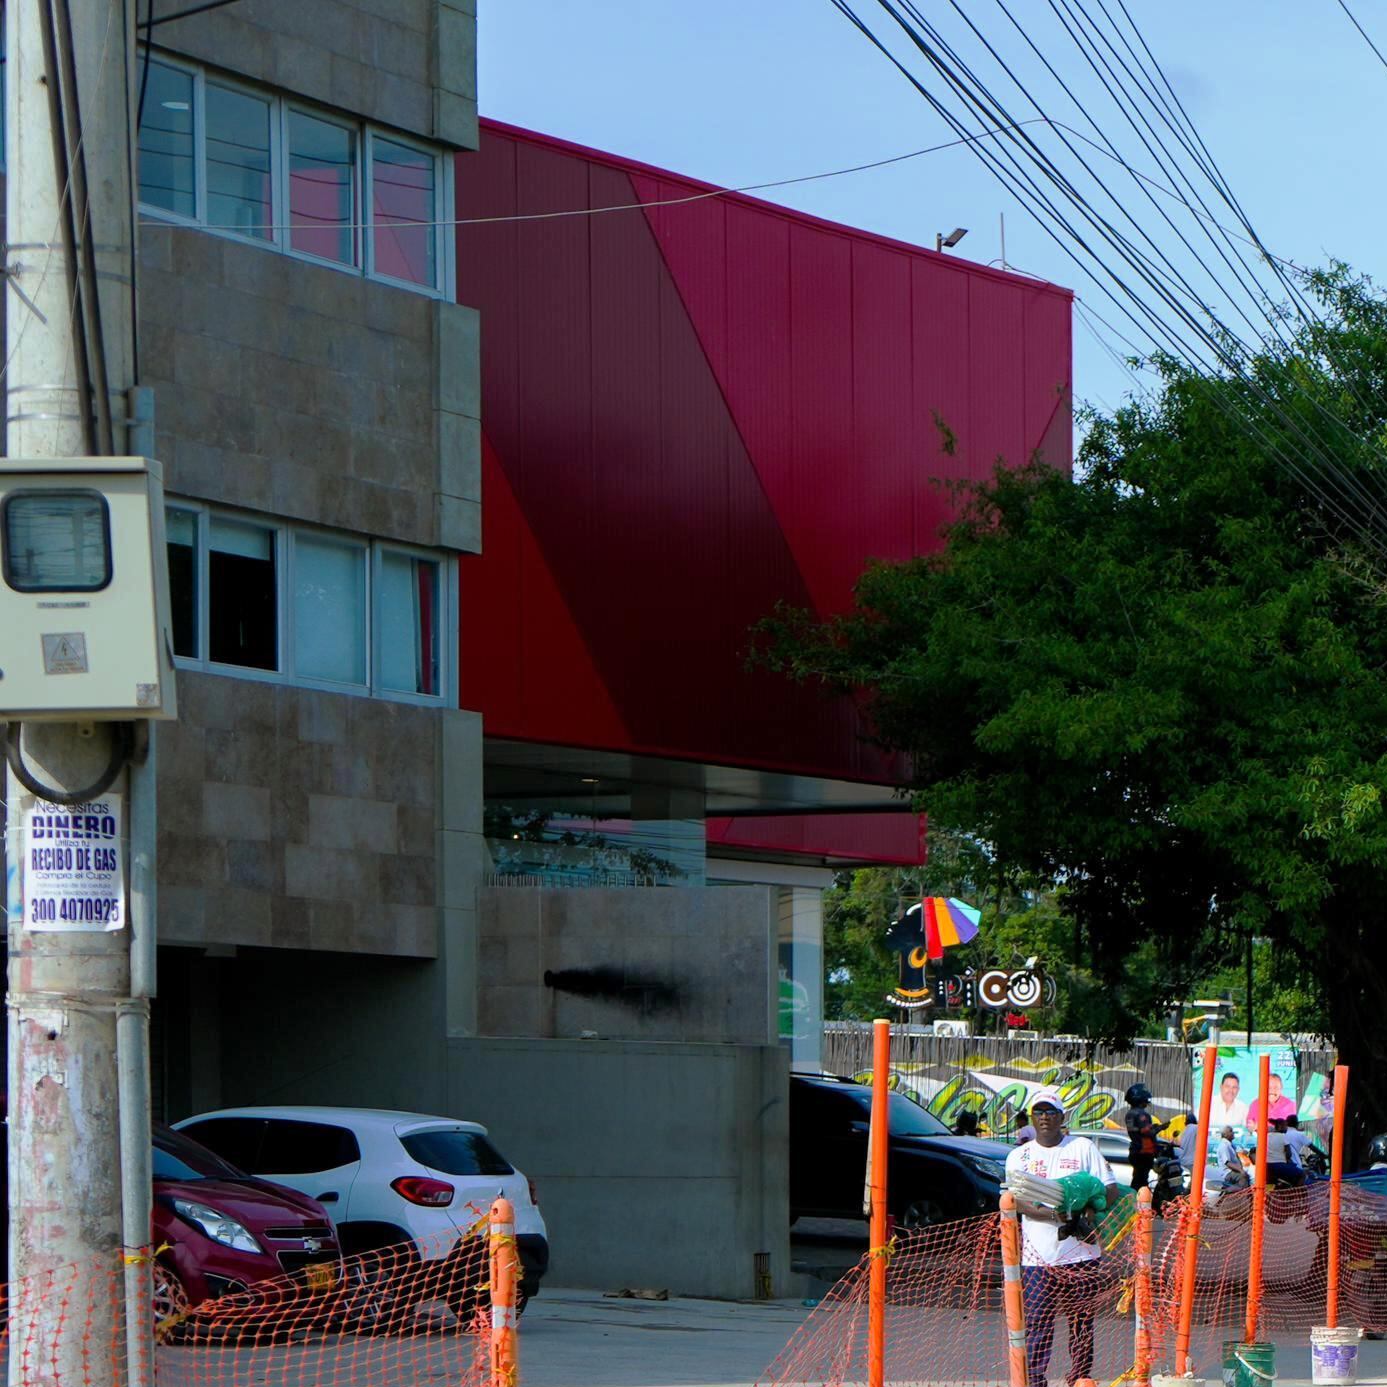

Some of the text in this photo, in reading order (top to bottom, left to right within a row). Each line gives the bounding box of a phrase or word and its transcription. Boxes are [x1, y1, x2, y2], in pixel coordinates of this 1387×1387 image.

[32, 815, 115, 839] DINERO
[32, 848, 117, 871] RECIBO DE GAS
[32, 898, 119, 922] 300 4070925
